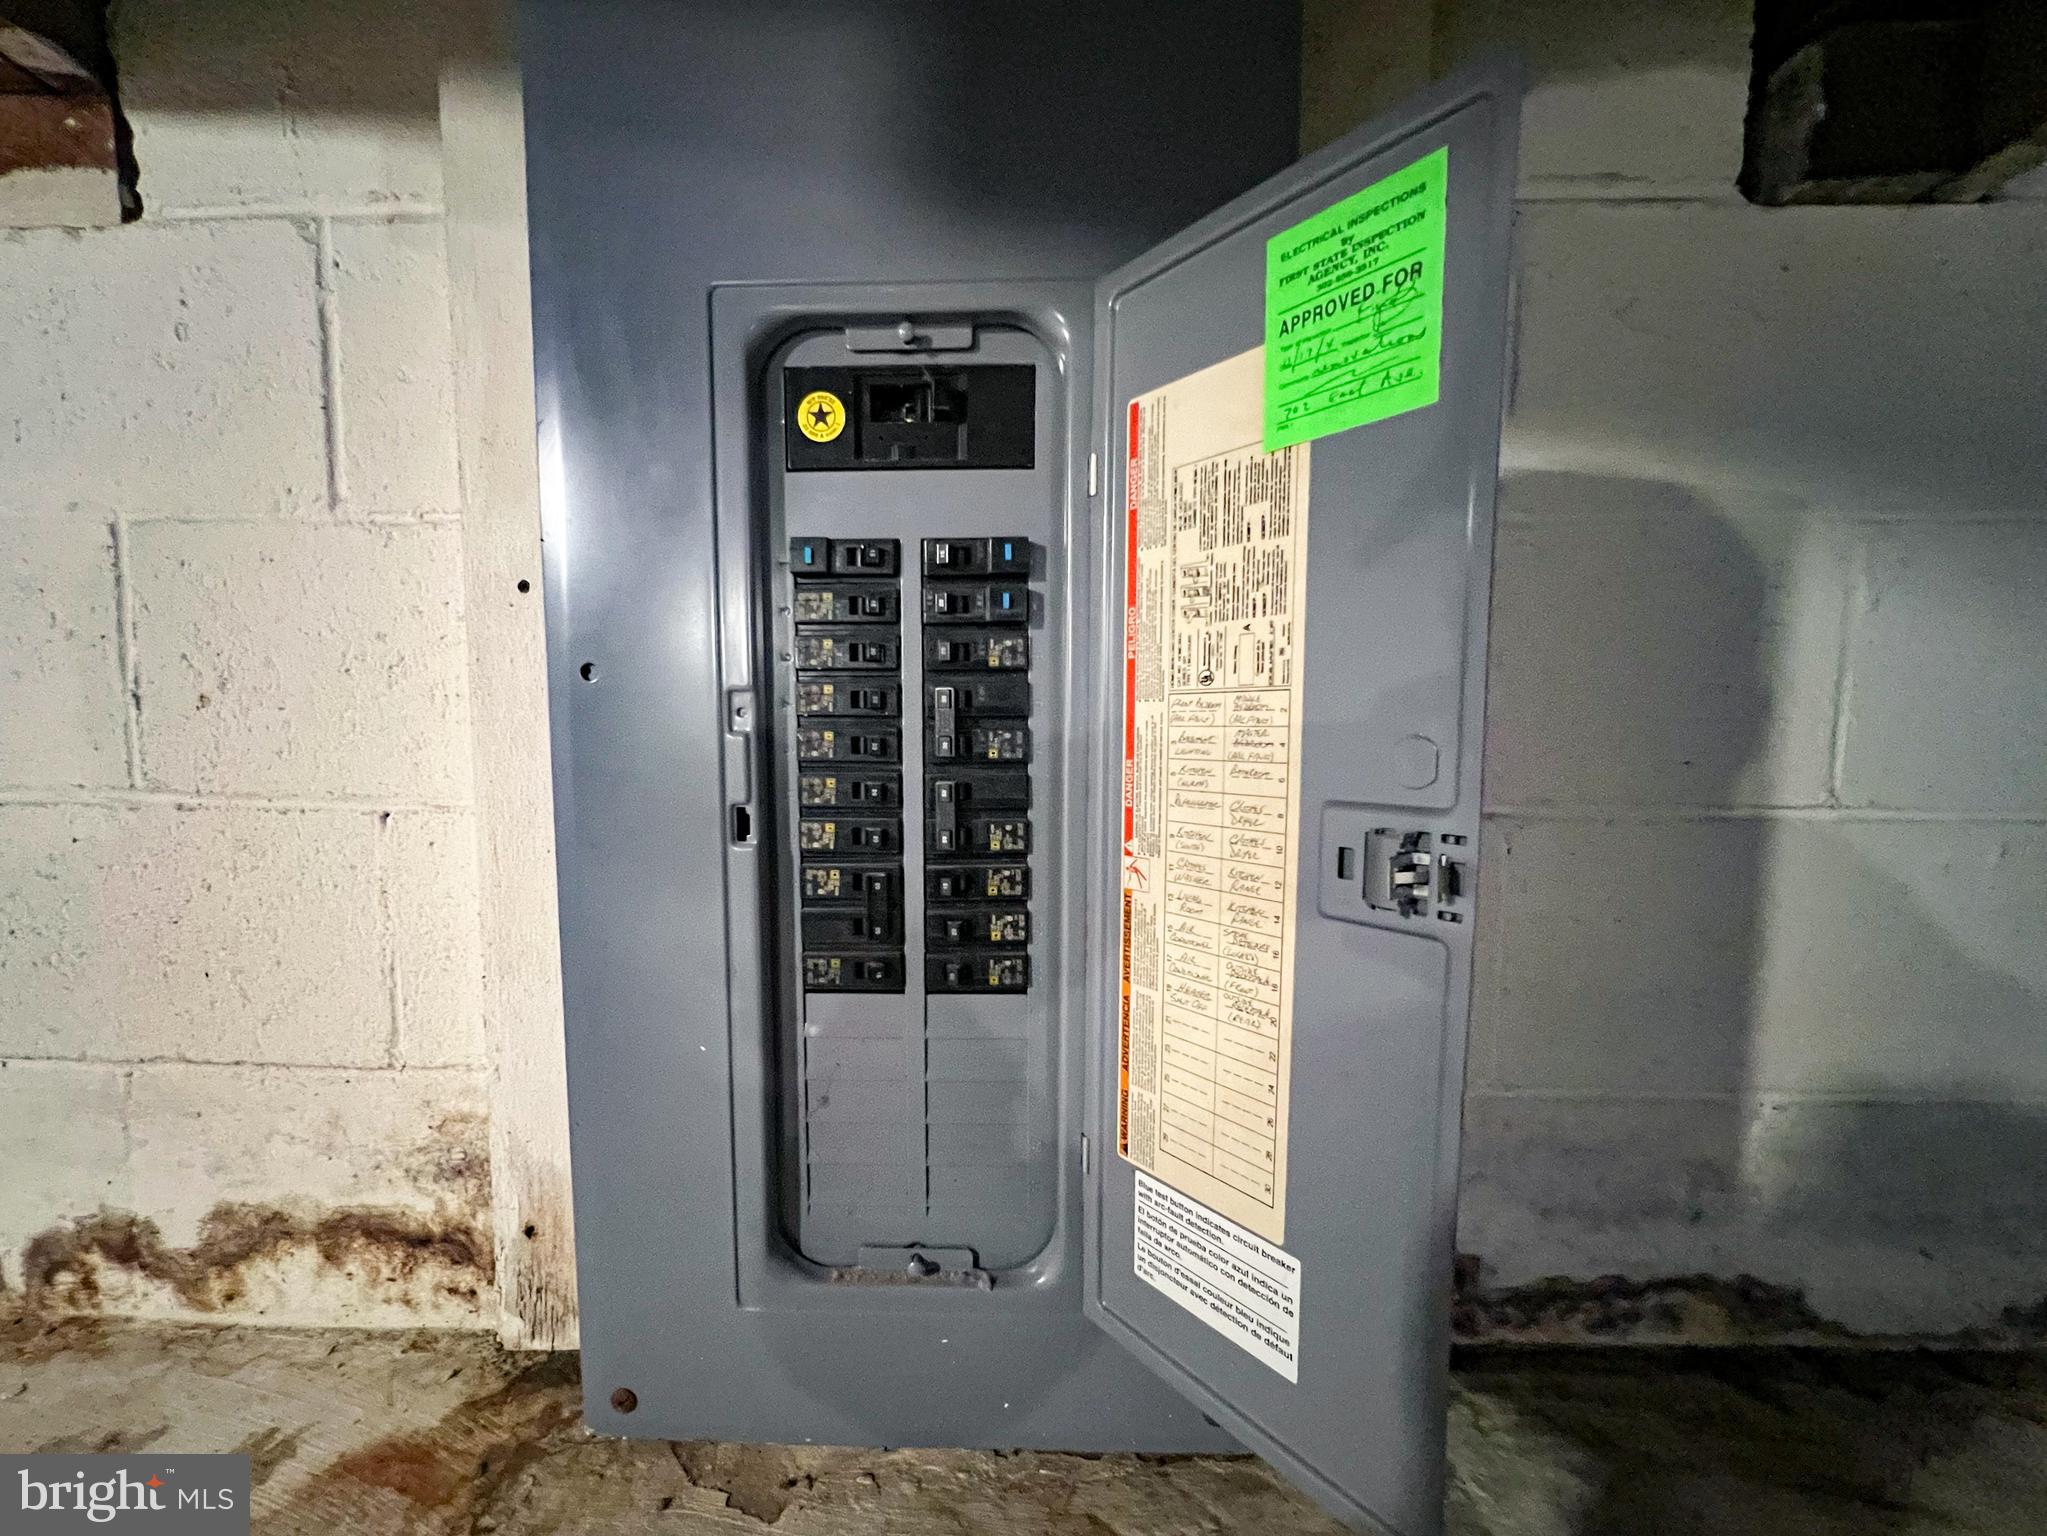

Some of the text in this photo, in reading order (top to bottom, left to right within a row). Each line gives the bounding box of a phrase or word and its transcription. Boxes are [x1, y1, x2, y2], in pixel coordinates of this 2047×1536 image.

[1281, 182, 1427, 263] ELECTRICAL INSPECTIONS
[1313, 248, 1348, 272] STATE
[1352, 209, 1426, 257] INSPECTION
[1279, 282, 1376, 338] APPROVED
[1382, 261, 1423, 295] FOR
[1129, 457, 1138, 510] DANGER
[1128, 607, 1136, 659] PELIGRO
[1125, 758, 1134, 808] DANGER
[1123, 893, 1132, 983] AVERTISSEMENT
[1121, 995, 1130, 1072] ADVERTENCIA
[1120, 1089, 1129, 1141] WARNING
[1137, 1226, 1152, 1241] falla
[1153, 1237, 1163, 1248] de
[1138, 1190, 1224, 1246] with arc-fault detection.
[1138, 1179, 1296, 1275] Blue test button indicates circuit breaker
[1138, 1205, 1145, 1215] El
[1168, 1225, 1178, 1237] de
[1179, 1231, 1207, 1253] prueba
[1208, 1248, 1230, 1267] color
[1231, 1262, 1249, 1279] azul
[1251, 1272, 1279, 1296] indica
[1281, 1293, 1294, 1305] un
[1137, 1216, 1175, 1243] interruptor
[1220, 1269, 1236, 1283] con
[1237, 1278, 1281, 1310] detección
[1282, 1306, 1294, 1319] de
[1137, 1242, 1290, 1347] Le bouton d'essai couleur bleu indique
[1137, 1253, 1293, 1362] un disjoncteur avec détection de défaut
